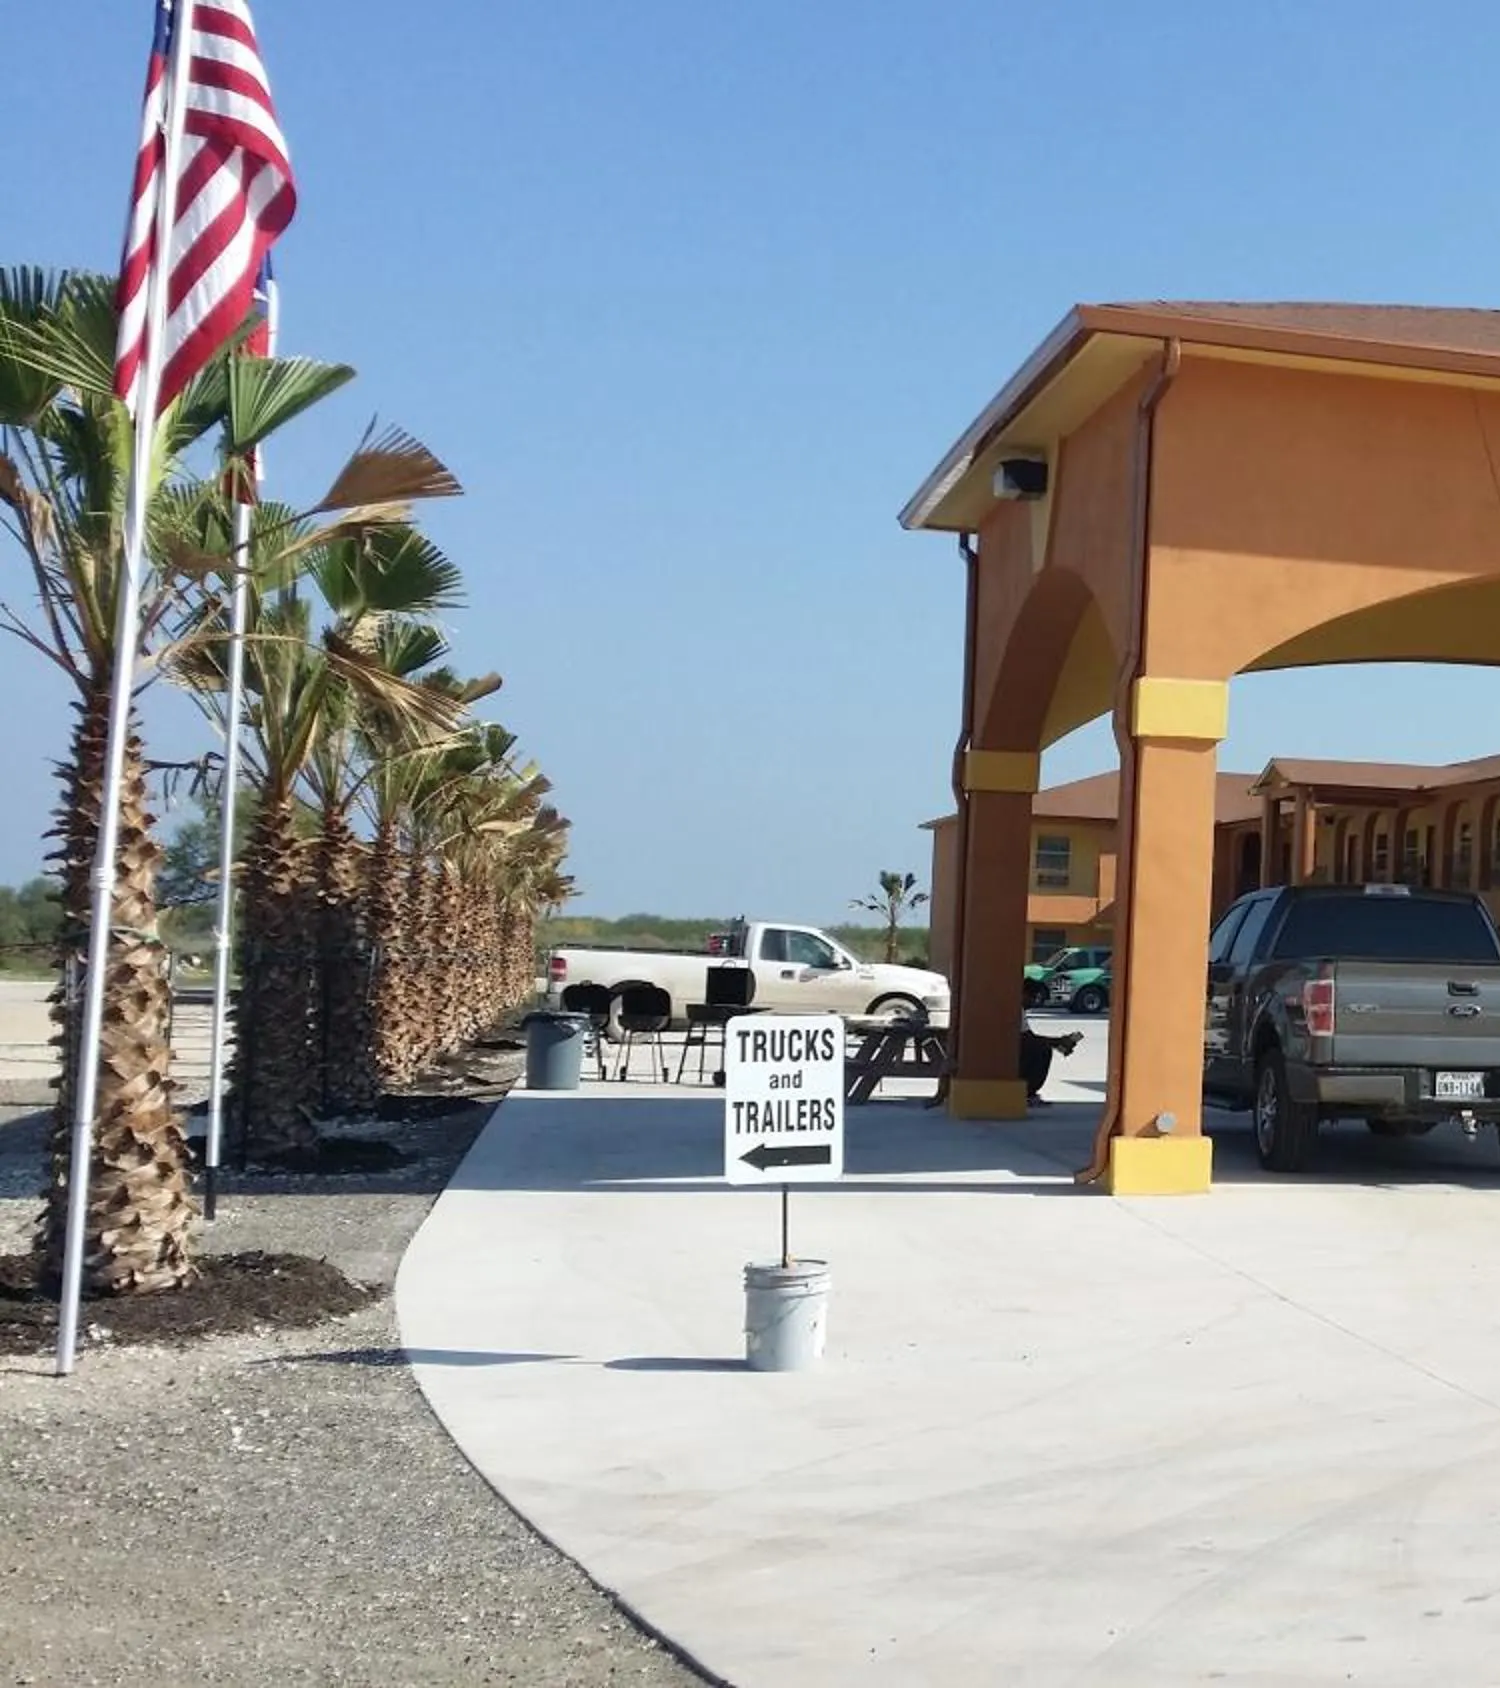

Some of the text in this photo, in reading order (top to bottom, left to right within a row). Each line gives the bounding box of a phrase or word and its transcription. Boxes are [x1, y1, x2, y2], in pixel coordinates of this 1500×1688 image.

[736, 1028, 835, 1063] TRUCKS
[769, 1069, 803, 1090] and
[732, 1097, 835, 1135] TRAILERS
